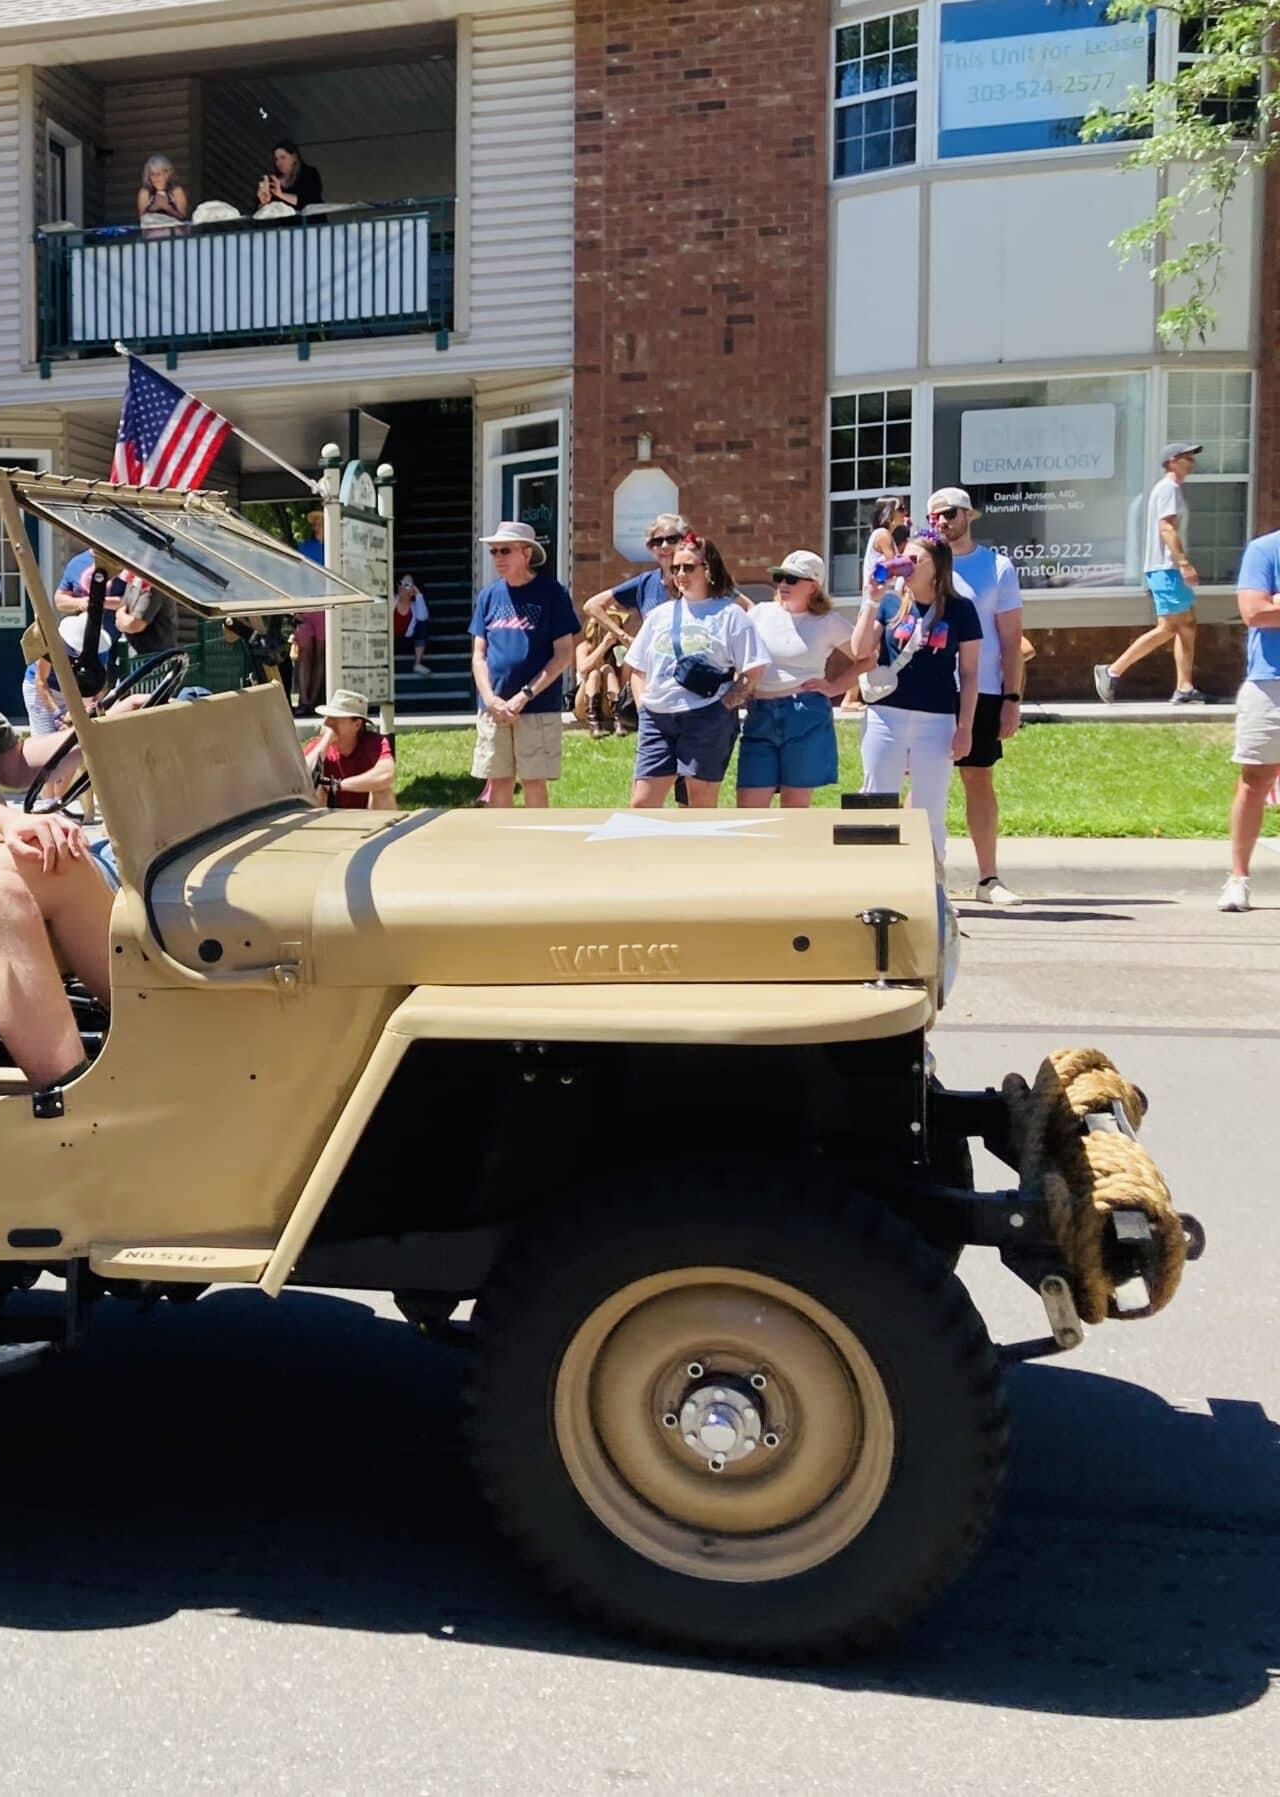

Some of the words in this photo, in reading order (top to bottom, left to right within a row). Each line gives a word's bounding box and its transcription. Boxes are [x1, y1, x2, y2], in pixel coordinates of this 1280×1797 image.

[943, 53, 985, 71] This
[992, 46, 1034, 66] Unit
[1039, 42, 1071, 62] for
[1085, 35, 1145, 56] Lease
[968, 72, 1116, 104] 303-524-2577
[972, 453, 1102, 473] DERMATOLOGY
[994, 491, 1022, 501] Daniel
[985, 503, 1020, 513] Hannah
